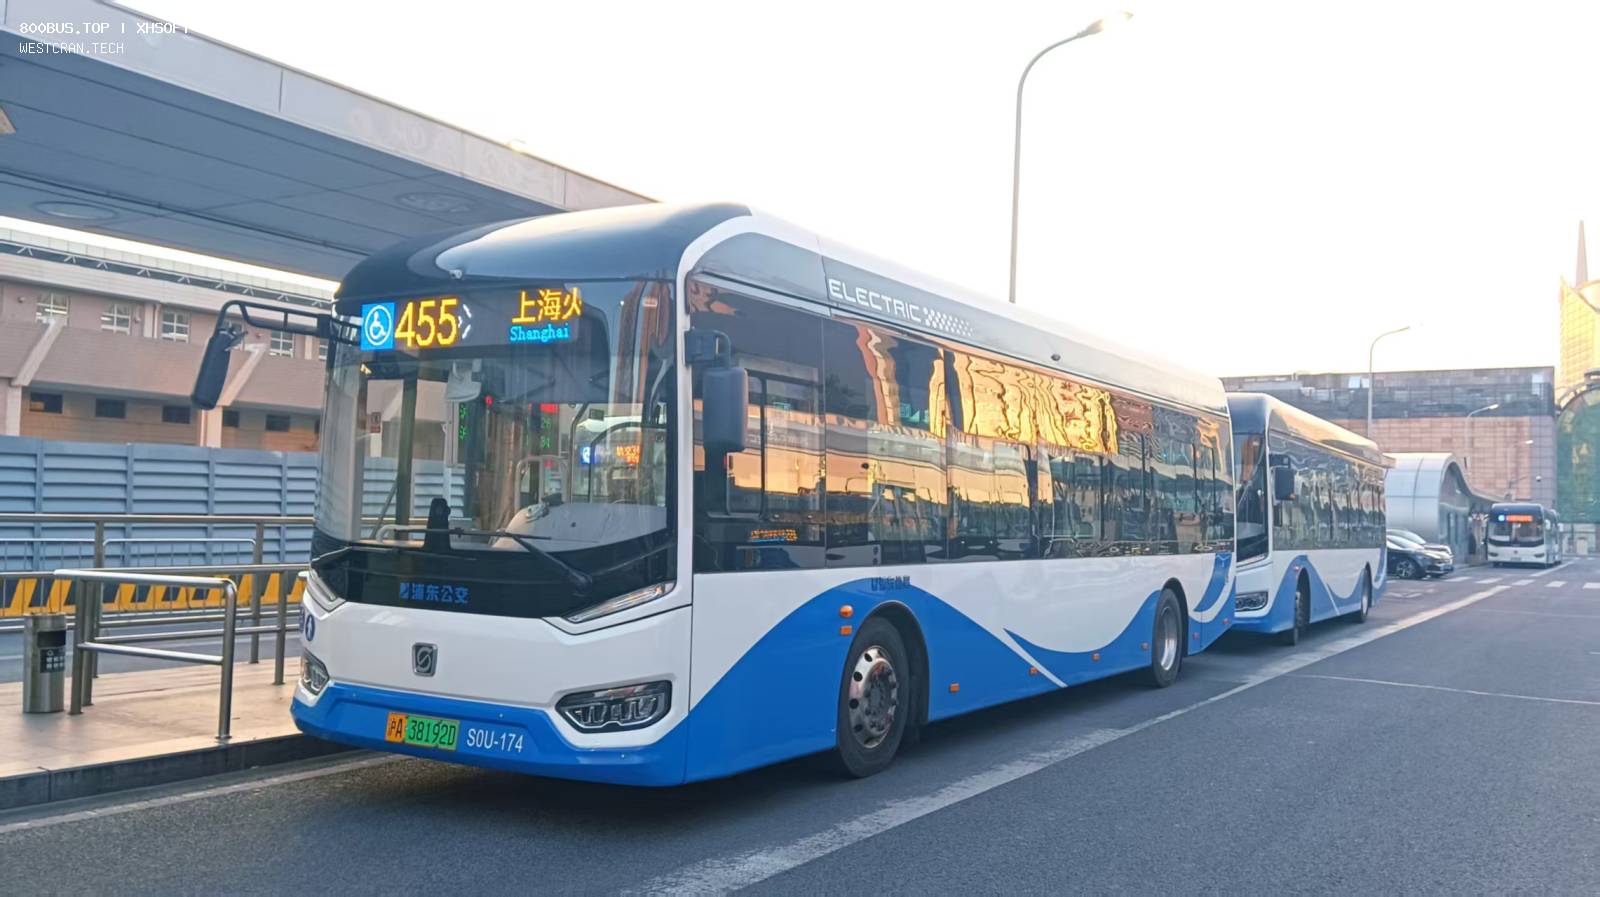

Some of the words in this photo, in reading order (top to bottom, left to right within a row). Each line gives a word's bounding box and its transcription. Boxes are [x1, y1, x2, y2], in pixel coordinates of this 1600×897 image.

[511, 287, 582, 324] 上海火
[828, 278, 922, 323] ELECTRIC
[394, 298, 458, 347] 455
[510, 322, 569, 342] Shanghai
